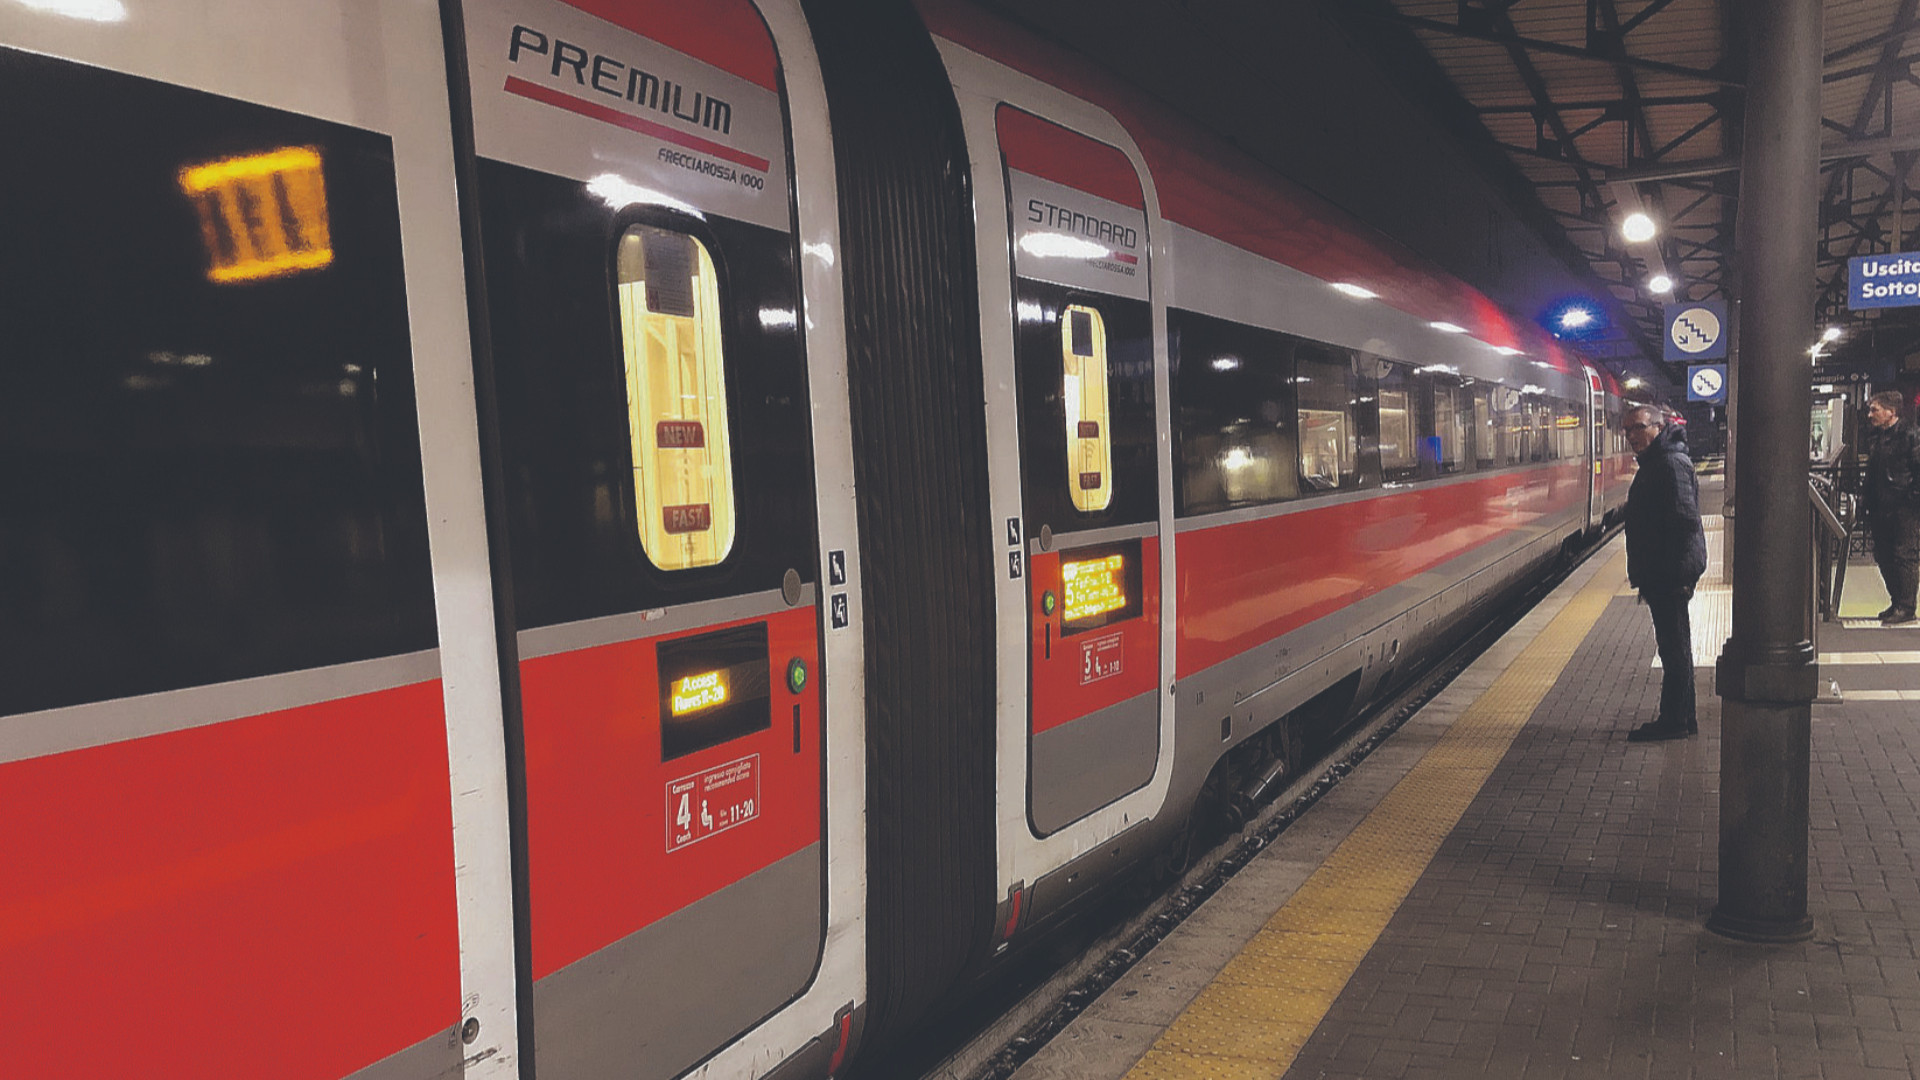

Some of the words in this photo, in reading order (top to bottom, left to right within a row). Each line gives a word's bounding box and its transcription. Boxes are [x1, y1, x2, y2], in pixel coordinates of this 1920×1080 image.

[508, 24, 731, 135] PREMIUM
[657, 148, 737, 184] FRECCIAROSSA
[740, 172, 764, 191] 1000
[1028, 199, 1137, 249] STANDARD
[1862, 281, 1920, 299] Sotto
[663, 425, 697, 445] NEW
[1084, 650, 1092, 675] 5
[676, 792, 692, 831] 4
